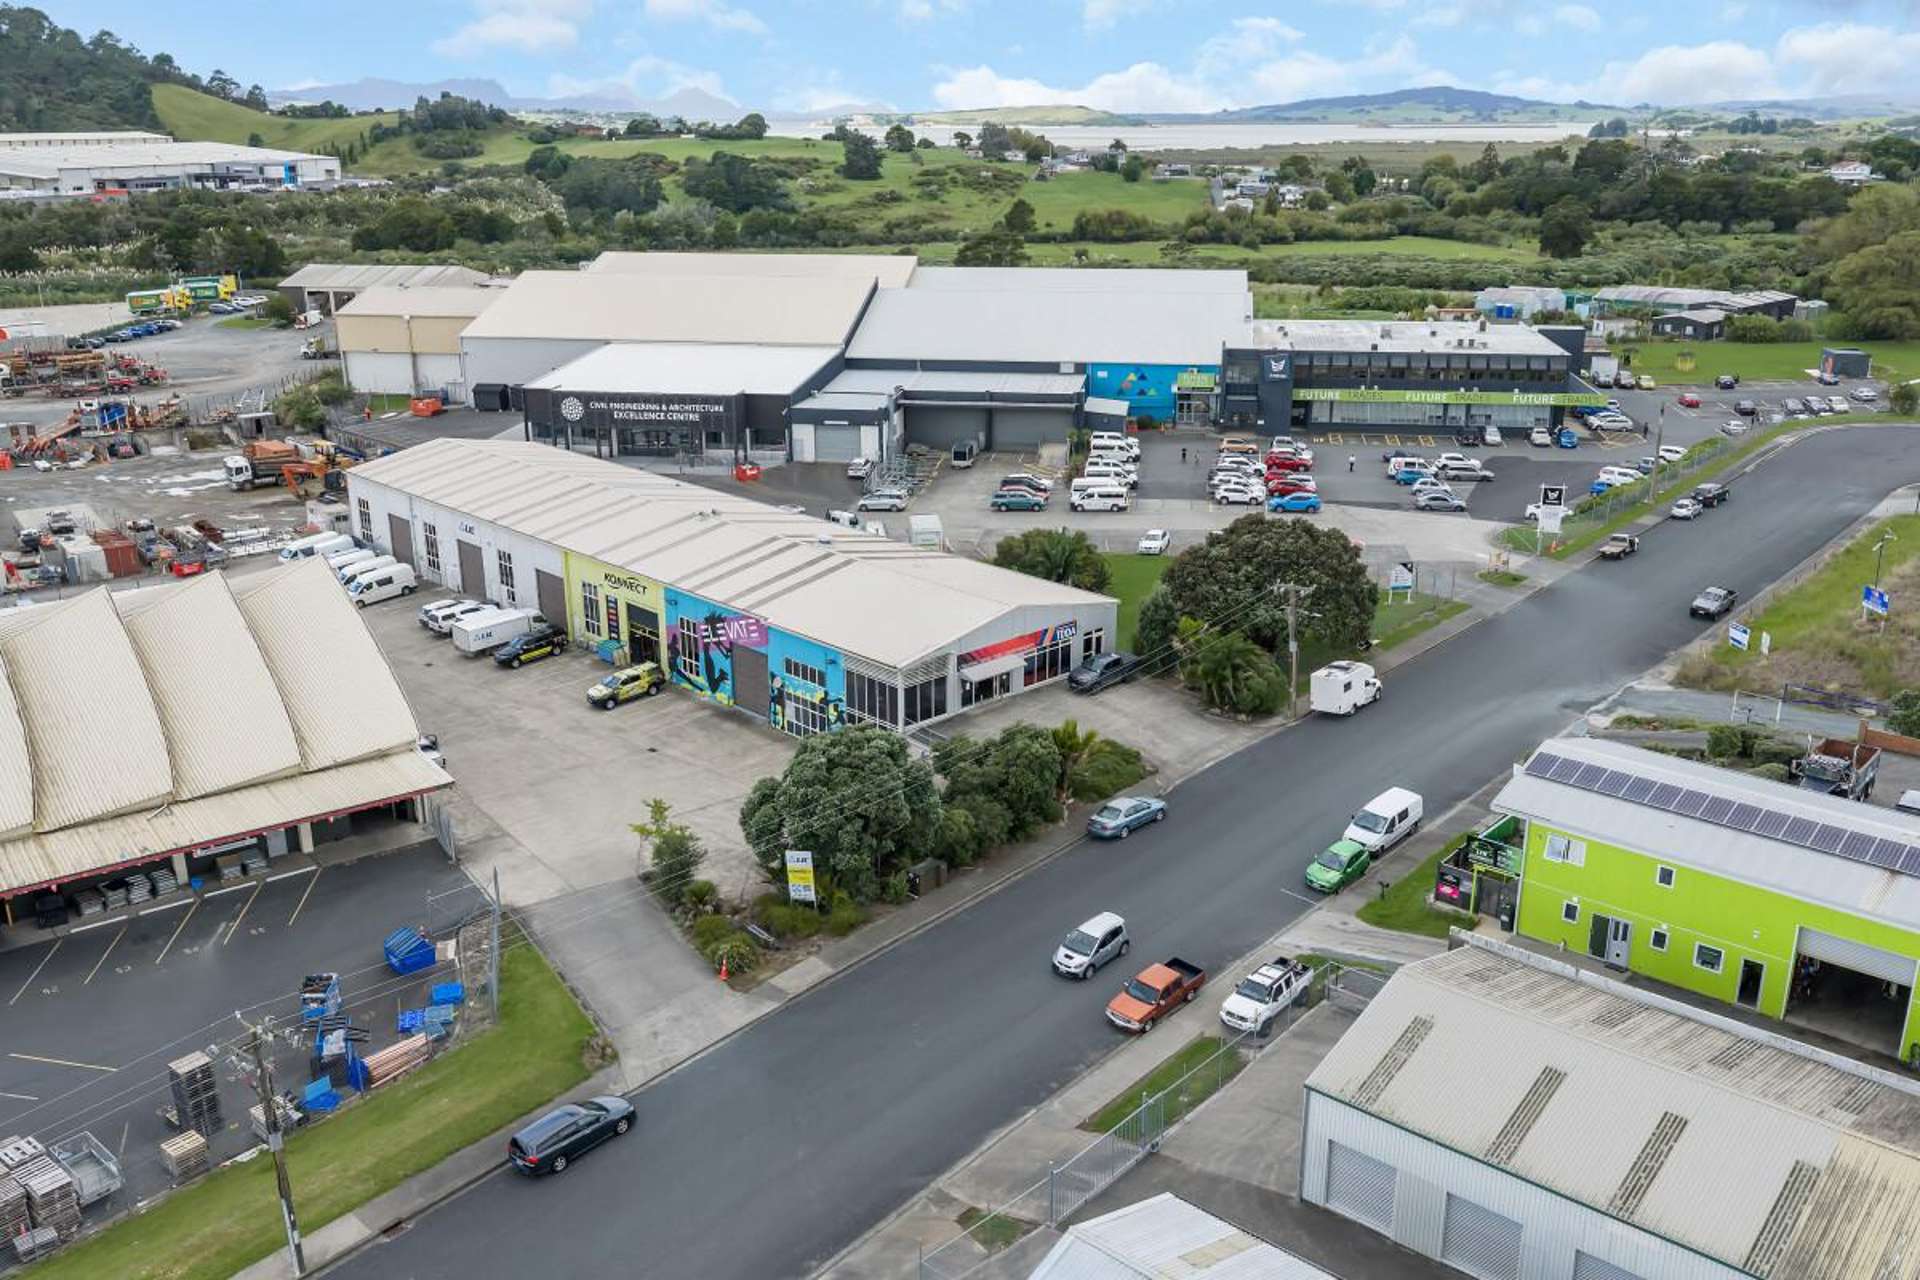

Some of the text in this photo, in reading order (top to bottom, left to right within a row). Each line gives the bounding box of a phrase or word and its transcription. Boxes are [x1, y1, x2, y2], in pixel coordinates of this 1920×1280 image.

[1300, 390, 1339, 400] FUTURE
[1406, 391, 1490, 403] FUTURE TRADE
[1513, 393, 1554, 405] FUTURE
[589, 401, 724, 413] CIVIL ENGINEERING & ARCHITECTURE
[614, 411, 700, 422] EXCELLENCE CENTRE
[604, 572, 648, 596] KONNECT
[700, 619, 760, 643] ELEVATE
